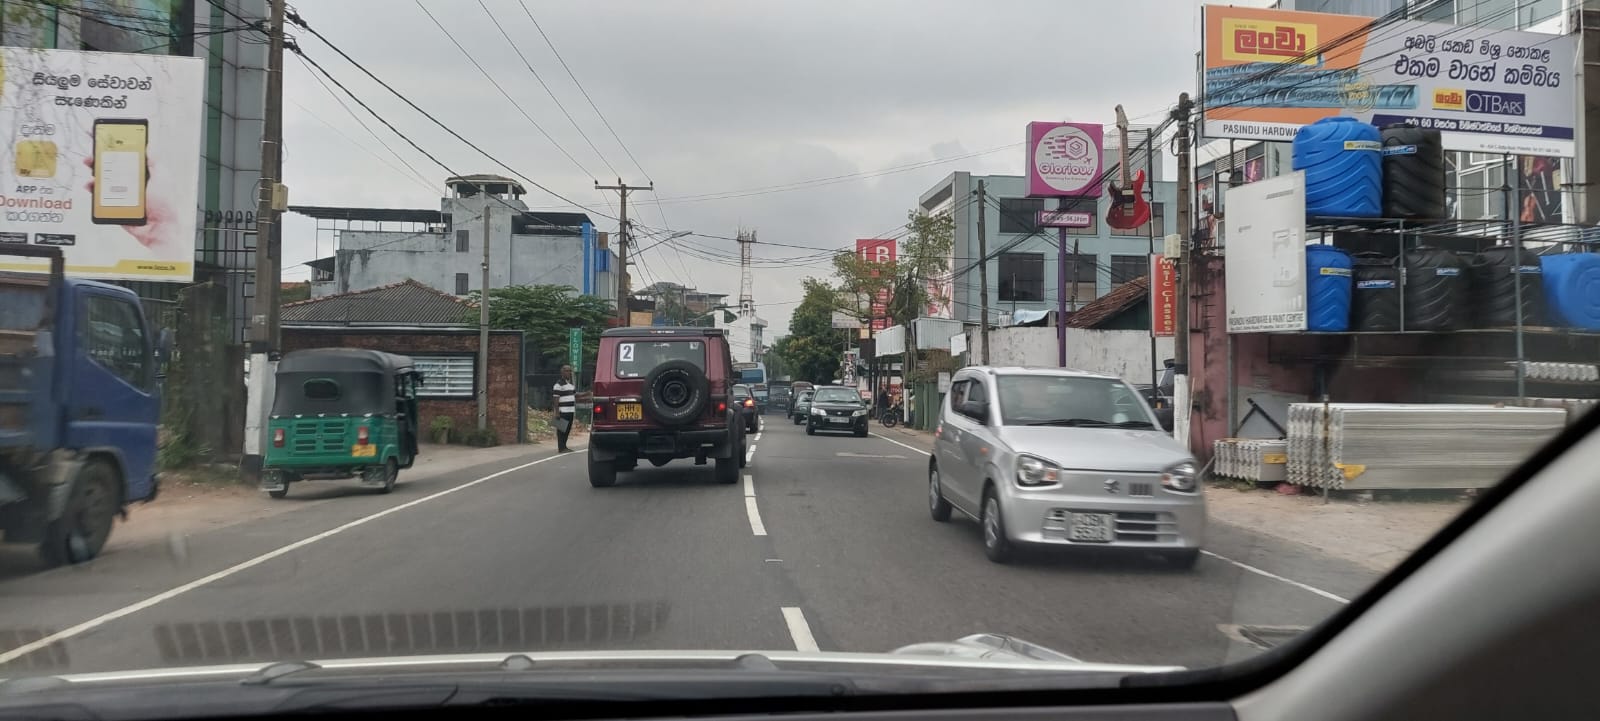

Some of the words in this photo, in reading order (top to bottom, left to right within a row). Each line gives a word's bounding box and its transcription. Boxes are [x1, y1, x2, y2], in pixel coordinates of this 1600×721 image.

[1234, 26, 1306, 57] ලංවා
[1442, 39, 1474, 54] යකඩ
[1507, 46, 1551, 63] නොකළ
[1394, 54, 1440, 78] එකම
[1449, 59, 1497, 82] වානේ
[1504, 64, 1561, 87] කම්බිය
[32, 72, 81, 90] සියලුම
[87, 75, 153, 90] සේවාවන්
[55, 95, 128, 109] සැණෙකින්
[1223, 124, 1260, 135] PASINDU
[1262, 126, 1300, 137] HARDWA
[1421, 118, 1432, 128] 60
[1039, 163, 1094, 176] Glorious
[16, 185, 37, 193] APP
[0, 195, 72, 210] Download
[623, 345, 632, 360] 2
